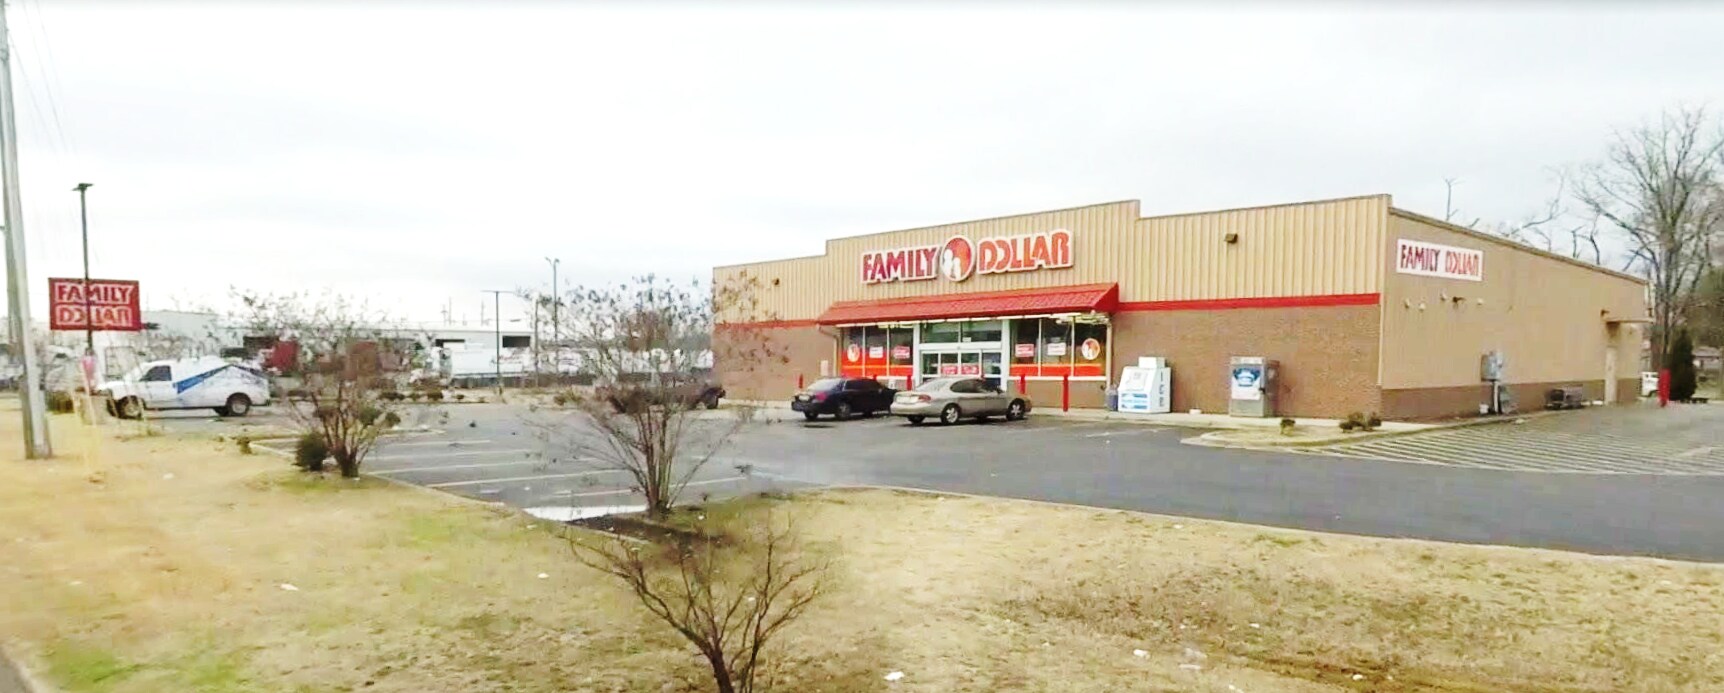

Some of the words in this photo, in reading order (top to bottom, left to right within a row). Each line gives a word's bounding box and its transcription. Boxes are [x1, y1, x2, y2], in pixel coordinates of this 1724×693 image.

[862, 246, 938, 282] FAMILY
[978, 230, 1072, 273] DOLLAR
[1400, 244, 1440, 272] FAMILY
[56, 283, 132, 304] FAMILY
[57, 306, 131, 324] DOLAR
